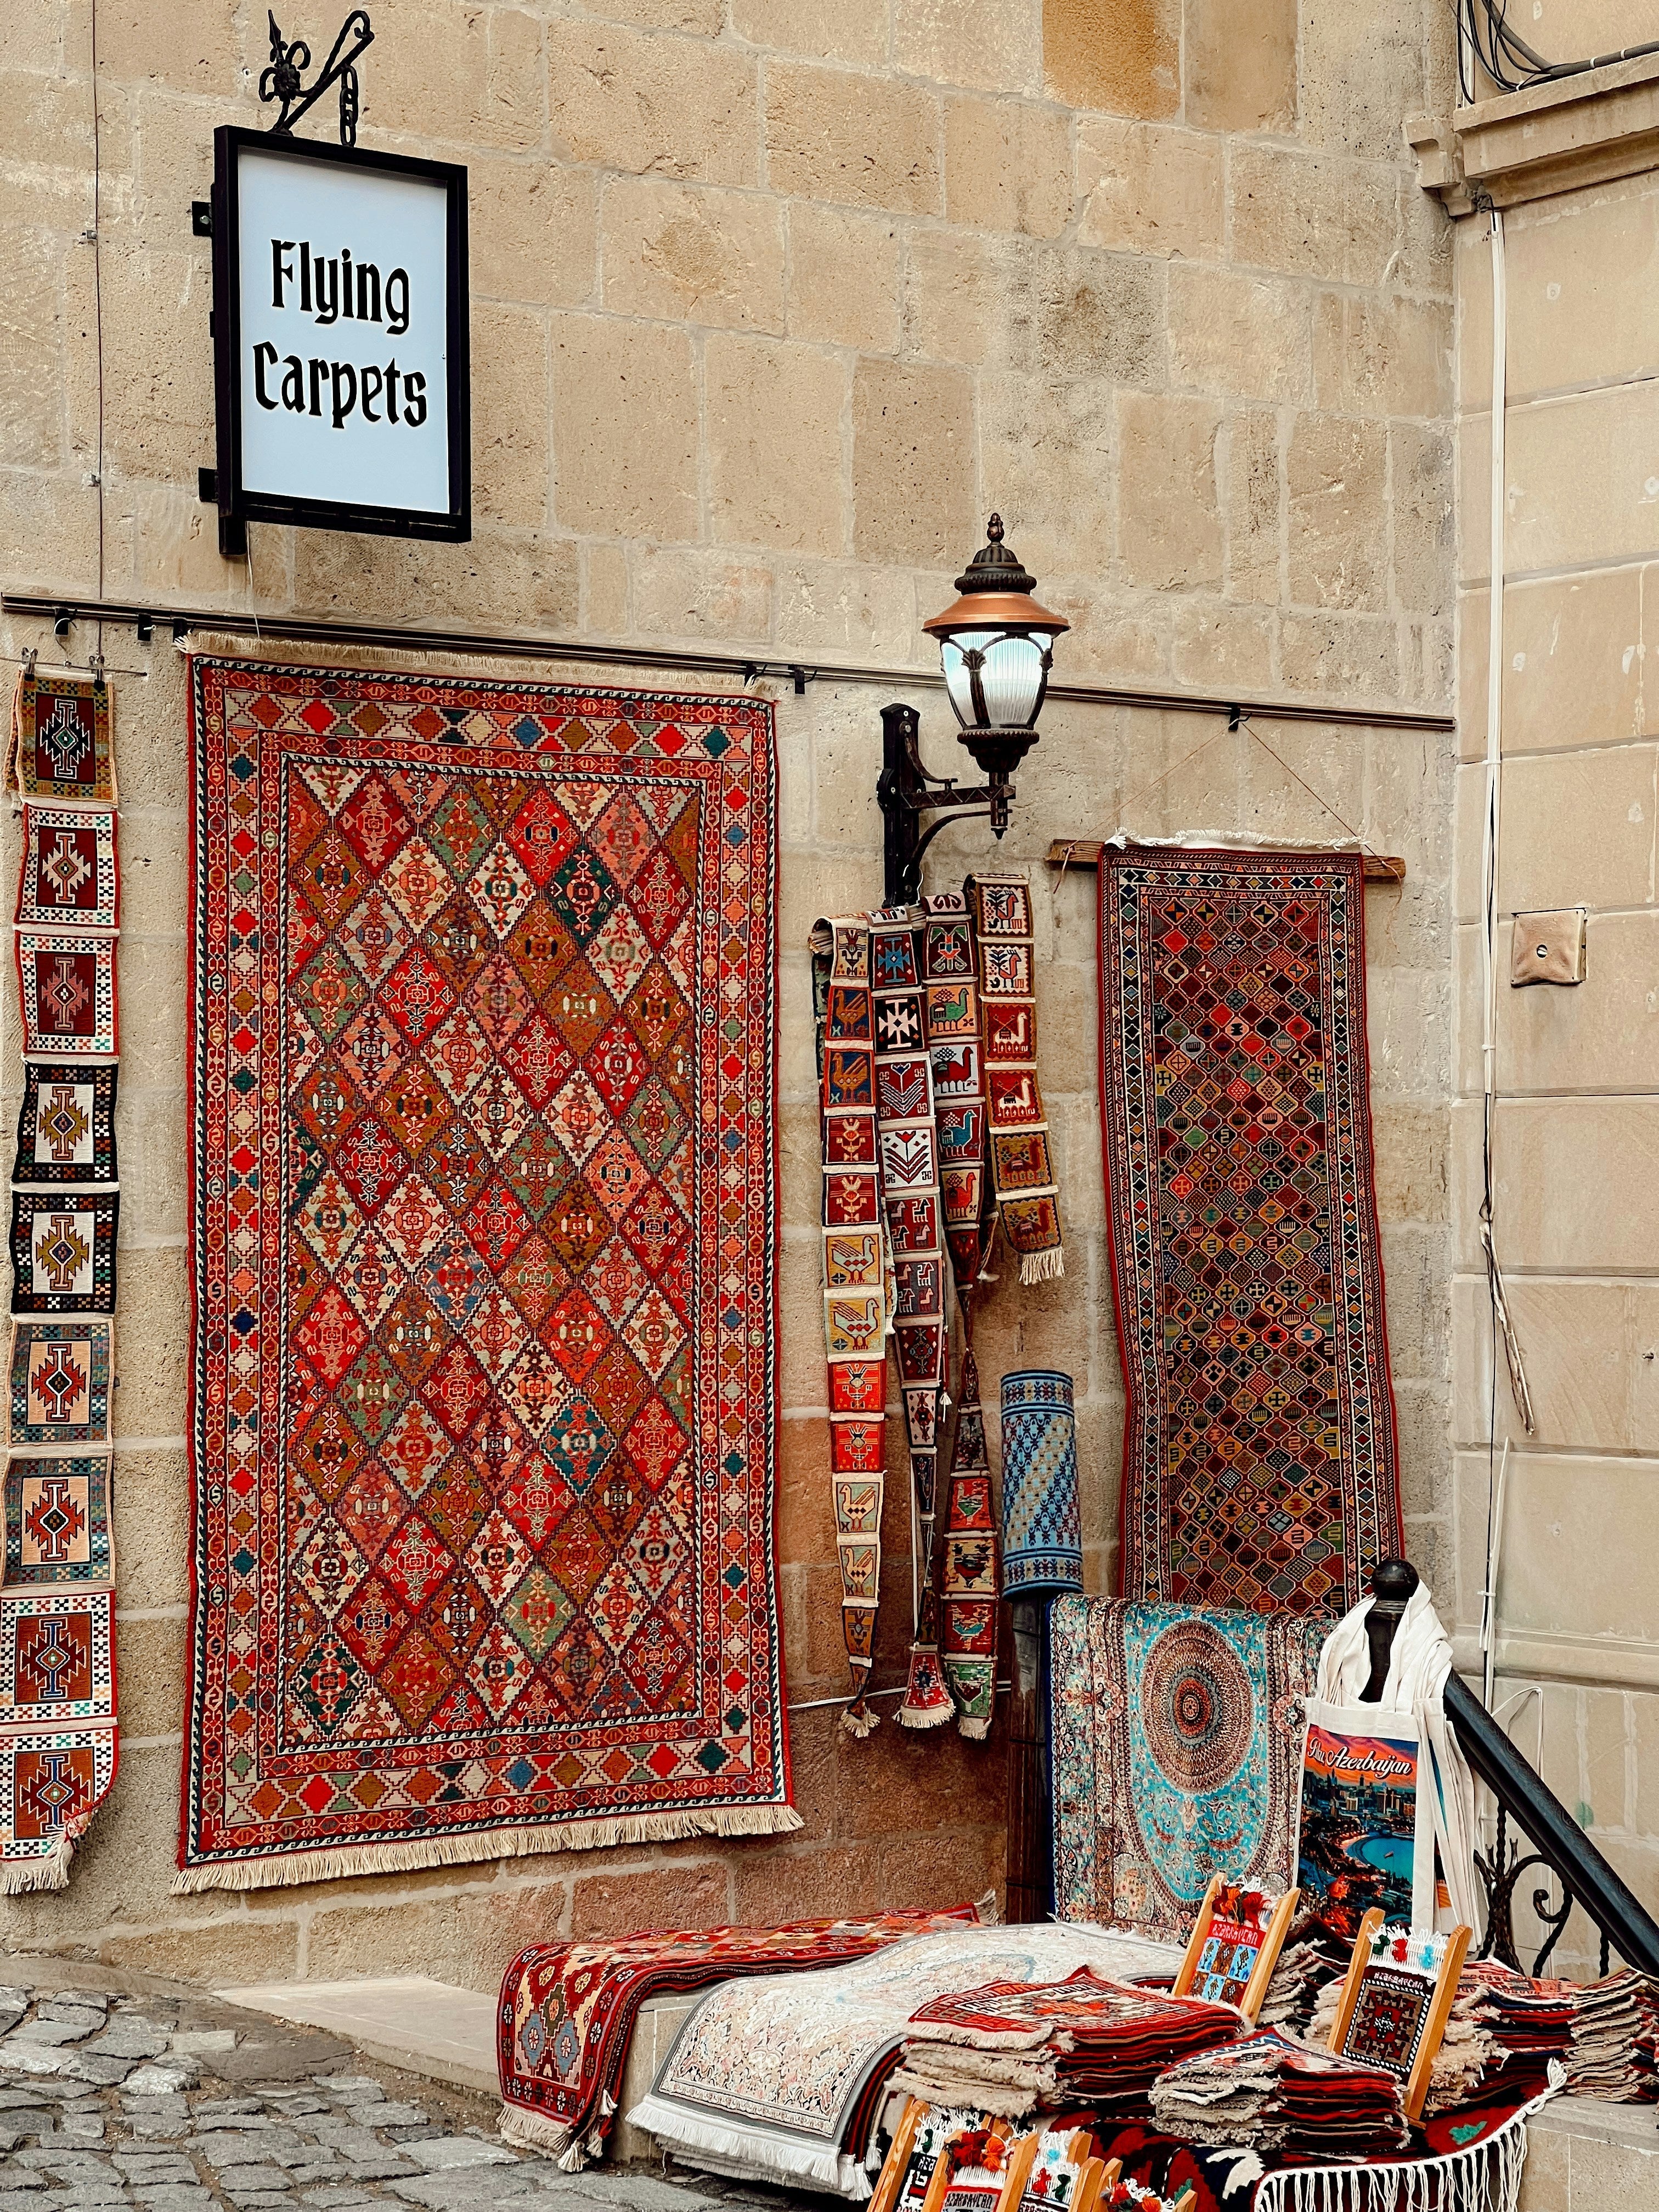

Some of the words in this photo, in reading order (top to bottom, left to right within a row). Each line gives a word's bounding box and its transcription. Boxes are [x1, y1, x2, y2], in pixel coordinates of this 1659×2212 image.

[271, 239, 409, 335] Flying
[252, 341, 427, 428] Carpets
[1327, 1746, 1411, 1778] Azerbaijan
